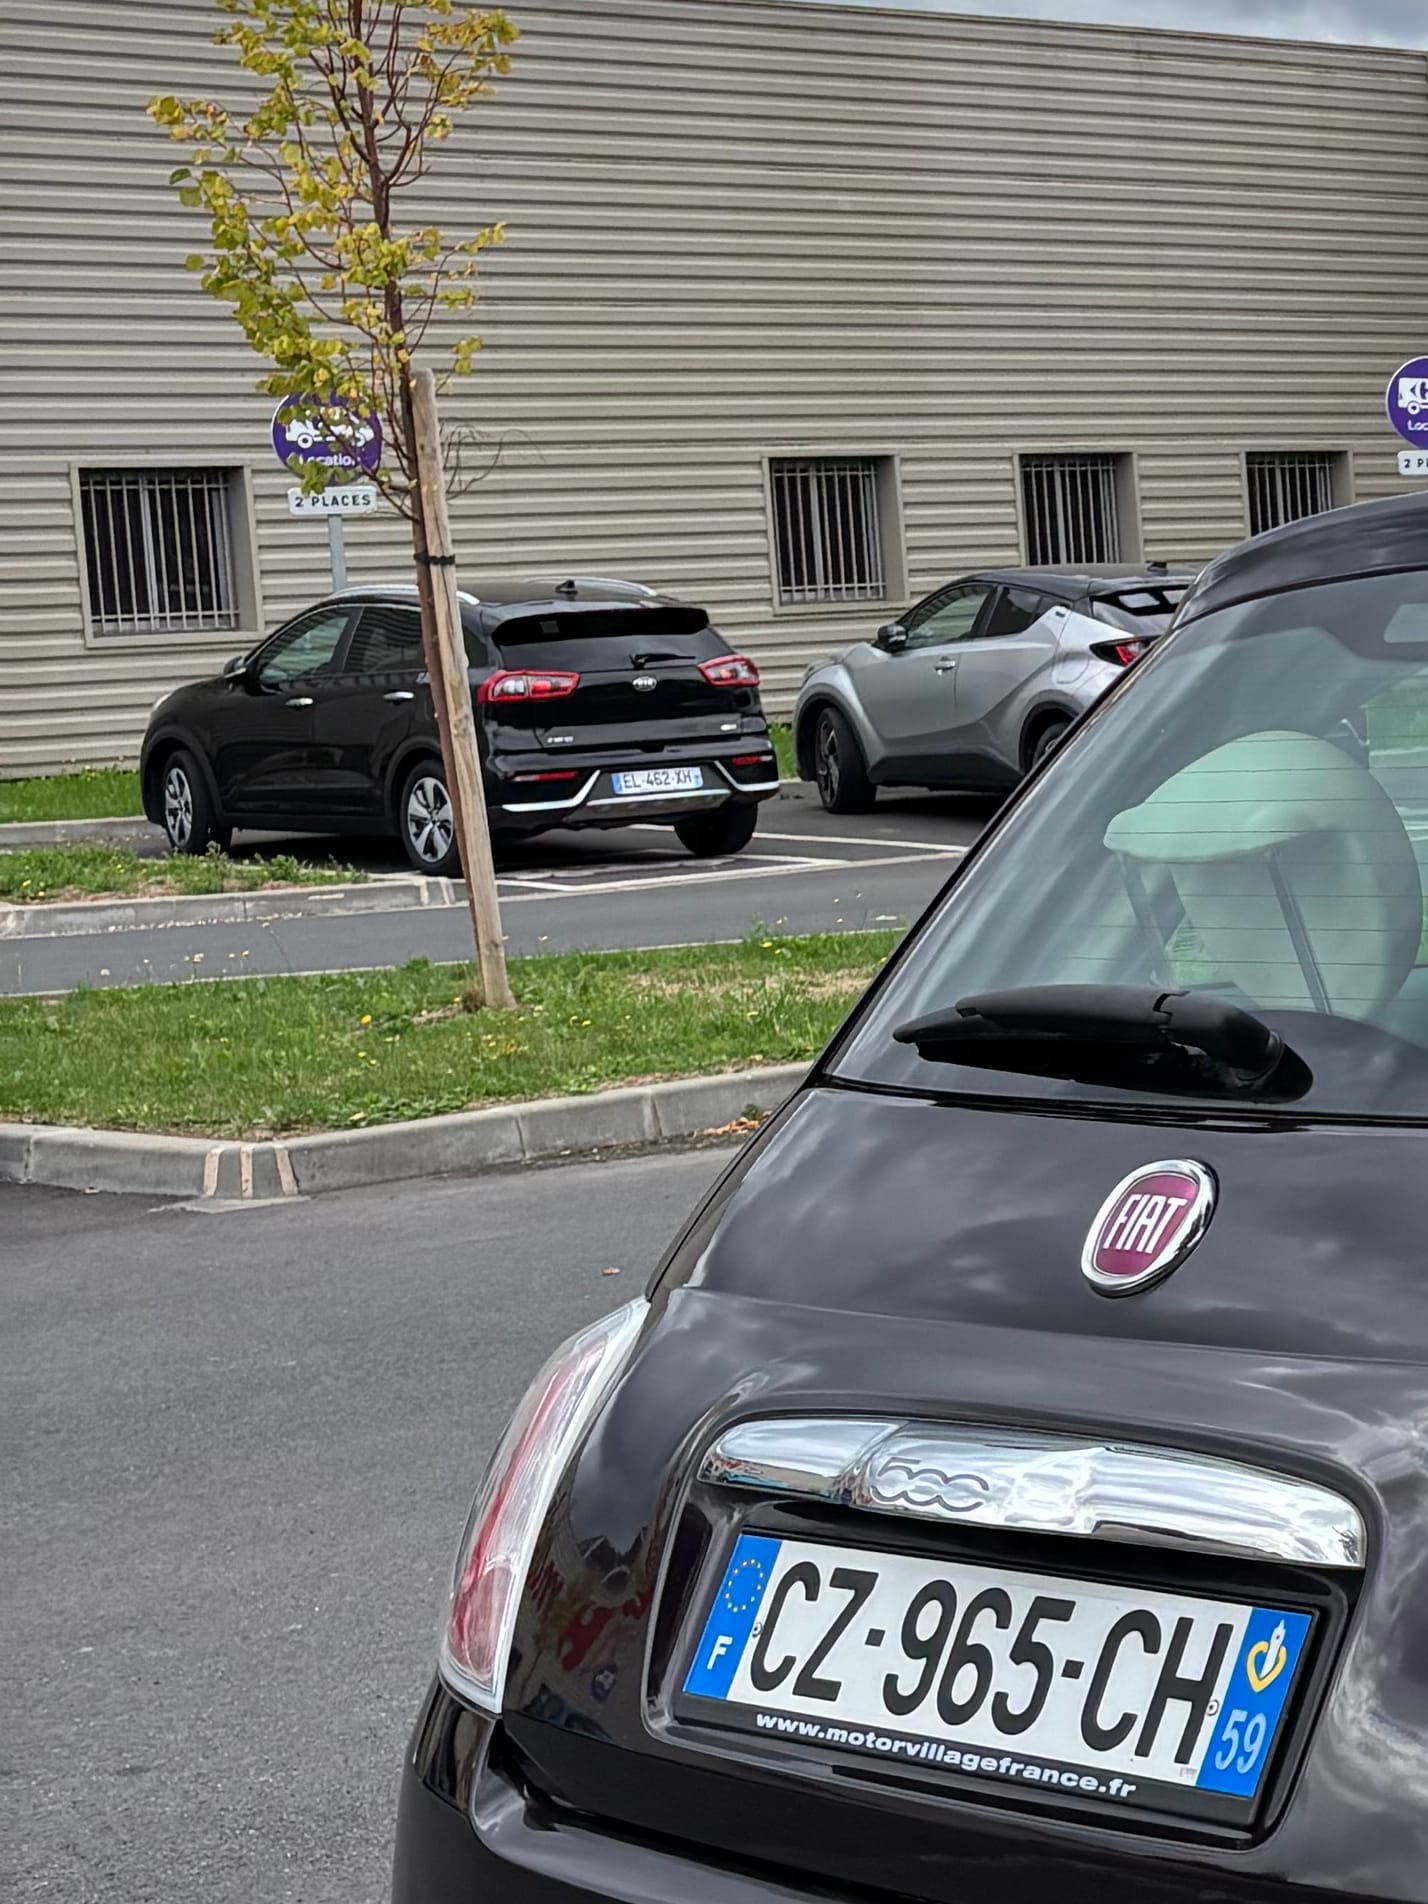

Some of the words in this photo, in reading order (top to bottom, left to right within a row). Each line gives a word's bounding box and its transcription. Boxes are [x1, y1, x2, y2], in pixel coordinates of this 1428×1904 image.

[1403, 458, 1411, 468] 2
[294, 497, 304, 508] 2
[311, 494, 371, 508] PLACES
[1102, 1194, 1188, 1254] FIAT
[870, 1456, 990, 1513] 500
[706, 1636, 732, 1670] F
[749, 1561, 1233, 1765] CZ-965-CH
[1214, 1709, 1268, 1775] 59
[755, 1711, 1137, 1798] www.motorvillagefrance.fr
